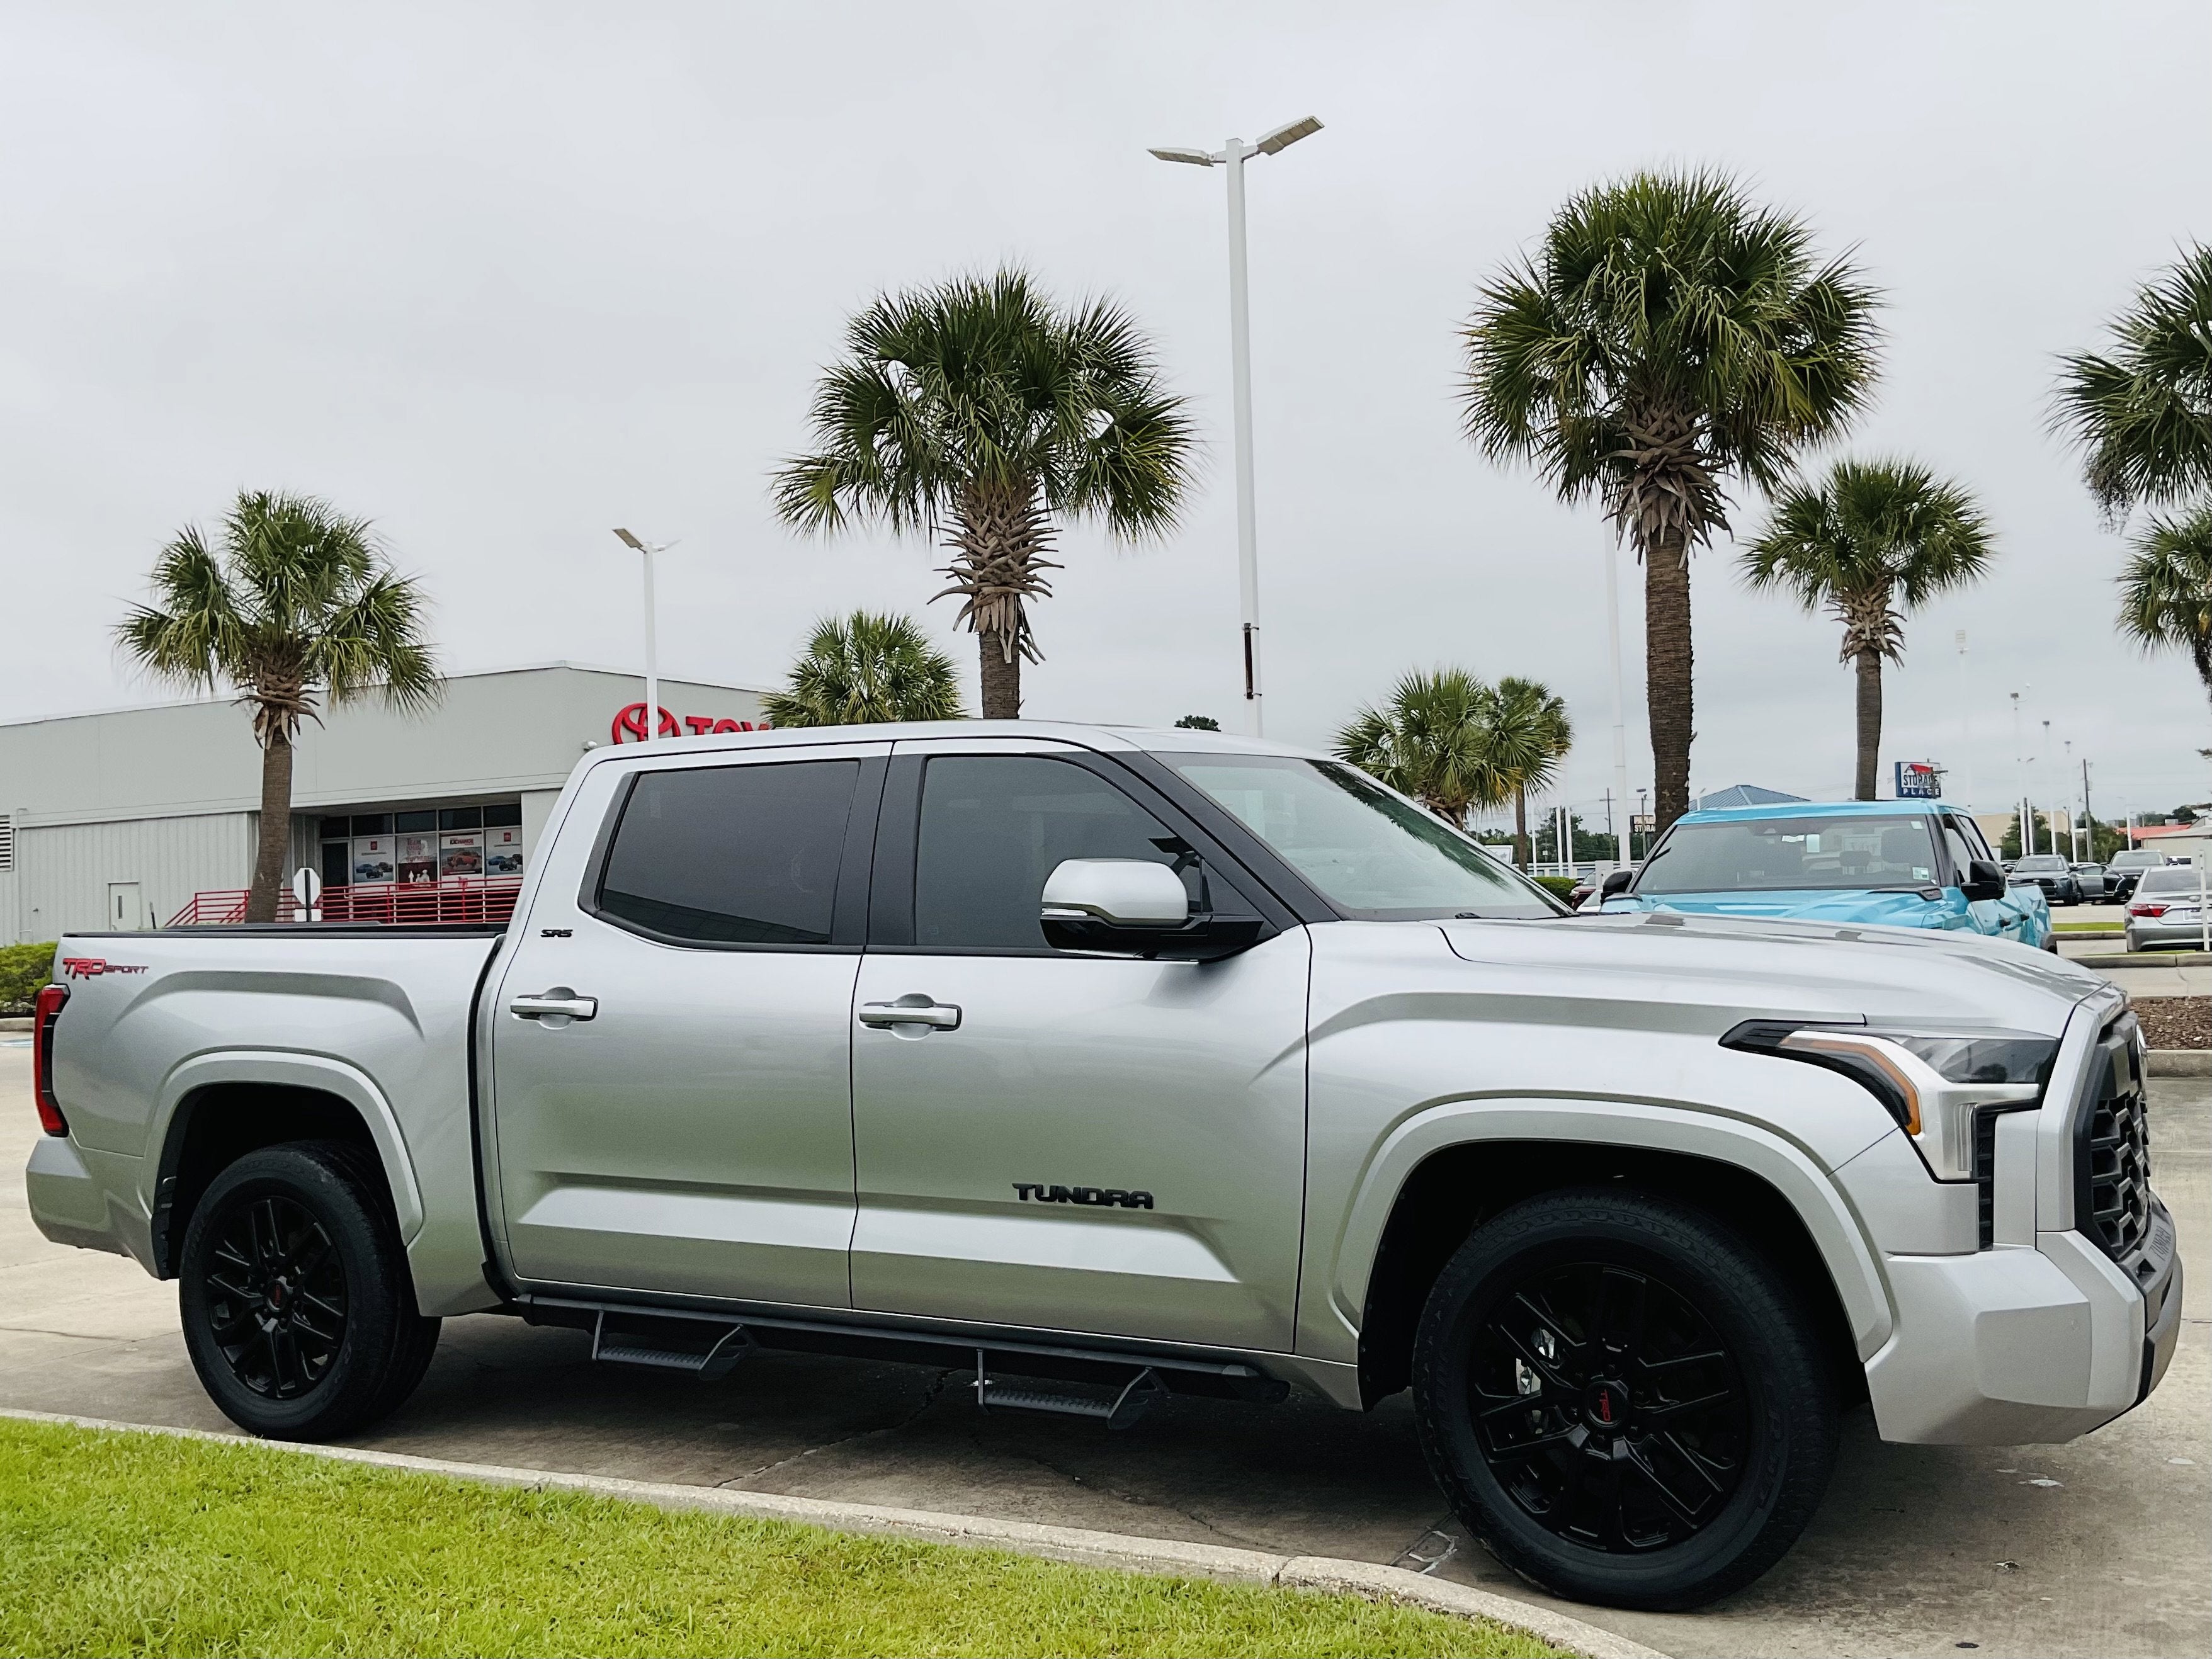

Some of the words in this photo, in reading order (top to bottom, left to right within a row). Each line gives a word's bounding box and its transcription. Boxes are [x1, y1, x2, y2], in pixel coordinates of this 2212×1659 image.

[1903, 788, 1939, 796] PLACE
[540, 929, 573, 937] SR5
[63, 958, 106, 980] TRD
[104, 965, 149, 974] SPORT
[1012, 1183, 1154, 1209] TUNDRA
[1599, 1389, 1611, 1421] TRD
